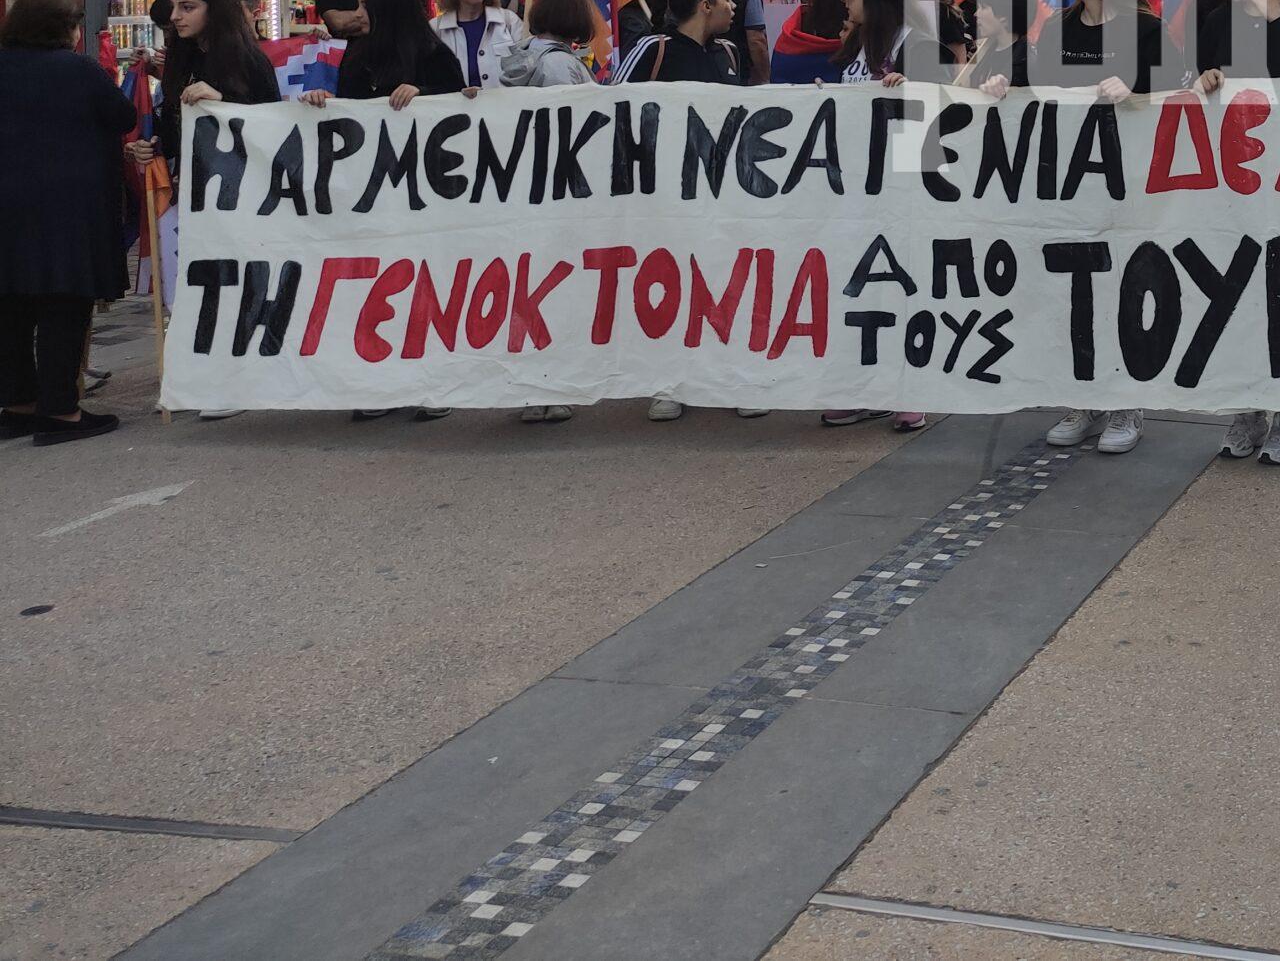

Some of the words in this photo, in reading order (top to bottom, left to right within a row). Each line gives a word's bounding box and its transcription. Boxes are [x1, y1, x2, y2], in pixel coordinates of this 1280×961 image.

[191, 113, 248, 213] Η
[257, 101, 662, 216] ΑΡΜΕΝΙΚΗ
[681, 97, 844, 199] ΝΕΑ
[864, 97, 1125, 204] ΓΕΝΙΑ
[187, 259, 303, 357] ΤΗ
[300, 246, 830, 364] ΓΕΝΟΚΤΟΝΙΑ
[843, 234, 1017, 300] ΑΠΟ
[844, 309, 1014, 384] ΤΟΥΣ
